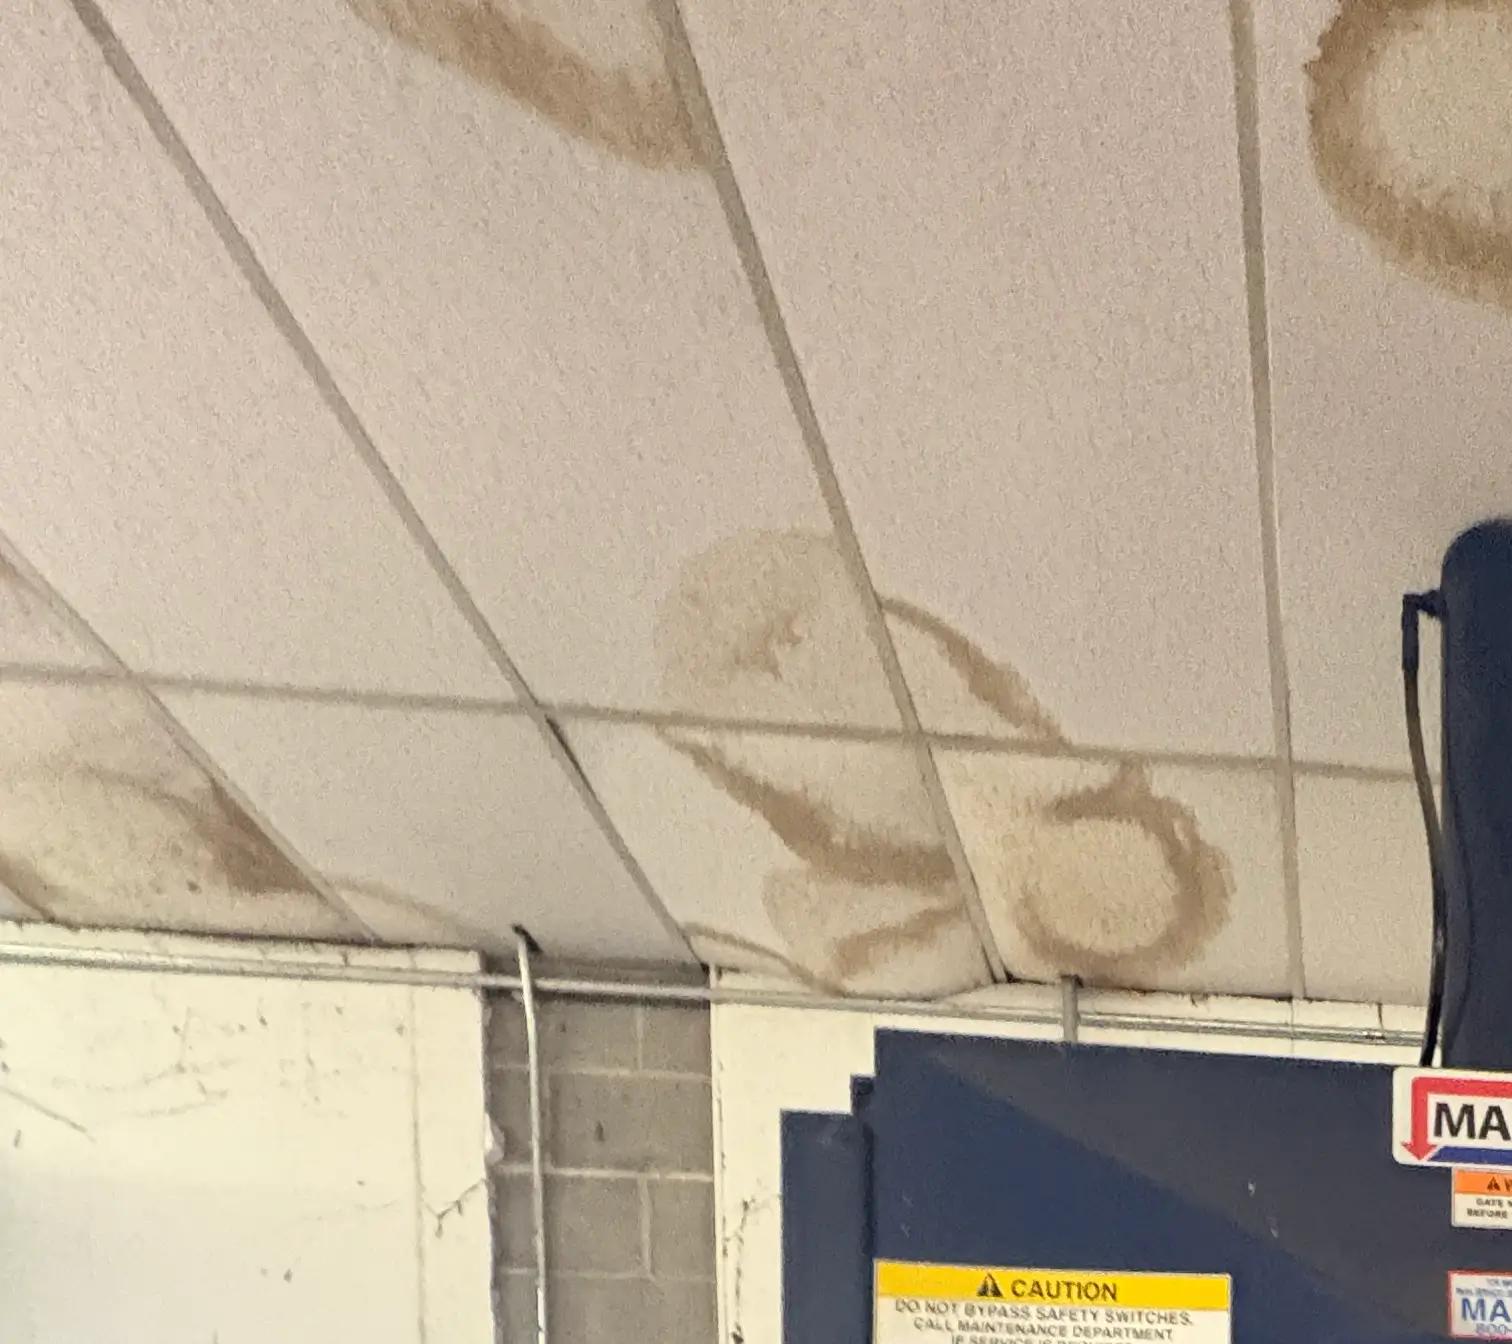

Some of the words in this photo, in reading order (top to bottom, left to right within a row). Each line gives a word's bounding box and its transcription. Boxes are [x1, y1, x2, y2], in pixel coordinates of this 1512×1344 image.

[1011, 1278, 1118, 1302] CAUTION
[895, 1299, 921, 1313] DO
[925, 1301, 958, 1314] NOT
[964, 1302, 1031, 1320] BYPASS
[1036, 1307, 1099, 1322] SAFETY
[914, 1316, 955, 1332] CALL
[958, 1319, 1067, 1337] MAINTENANCE
[1073, 1326, 1174, 1341] DEPARTMENT
